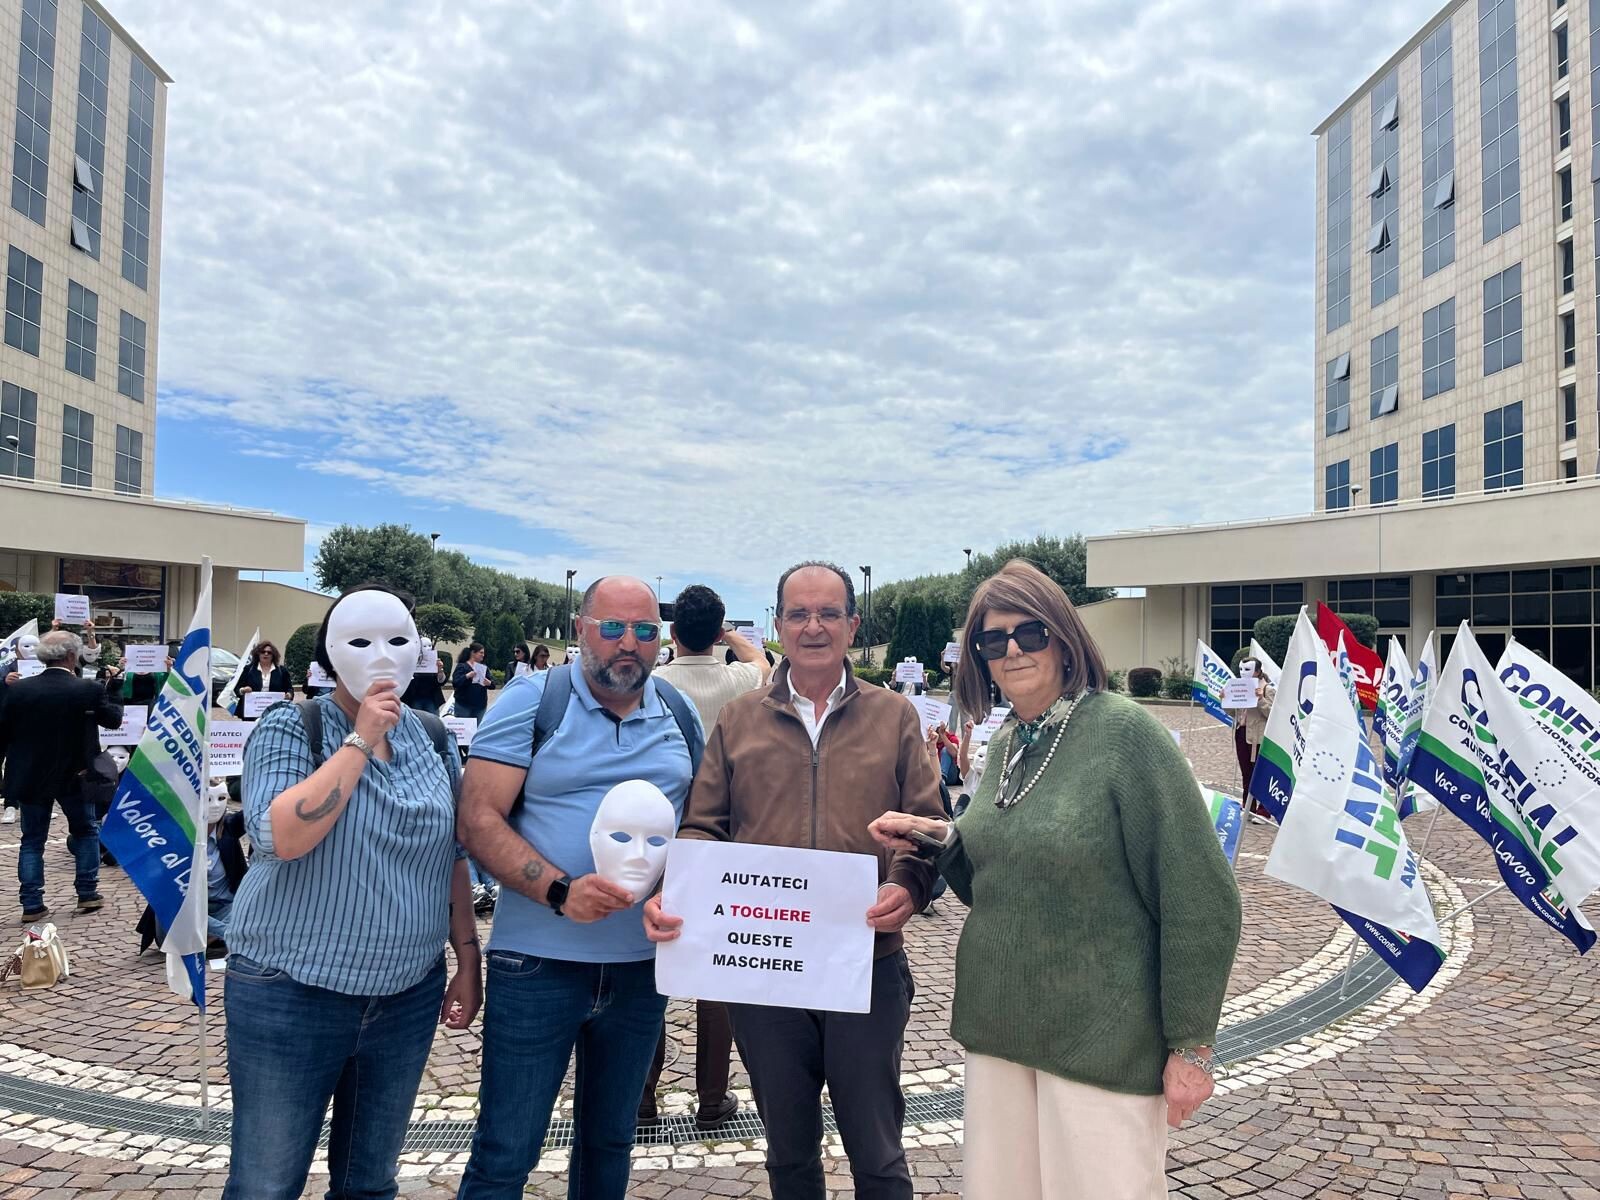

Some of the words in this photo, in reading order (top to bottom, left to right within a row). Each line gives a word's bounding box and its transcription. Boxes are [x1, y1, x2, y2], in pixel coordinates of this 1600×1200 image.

[157, 693, 203, 772] NFEDER
[1268, 776, 1289, 806] Voce
[1435, 768, 1458, 795] Voce
[1460, 793, 1472, 804] e
[116, 790, 167, 849] Valore
[161, 852, 189, 870] al
[1495, 839, 1536, 886] Lavoro
[721, 872, 808, 890] AIUTATECI
[713, 904, 725, 916] A
[730, 905, 811, 922] TOGLIERE
[727, 932, 793, 948] QUESTE
[712, 954, 804, 972] MASCHERE
